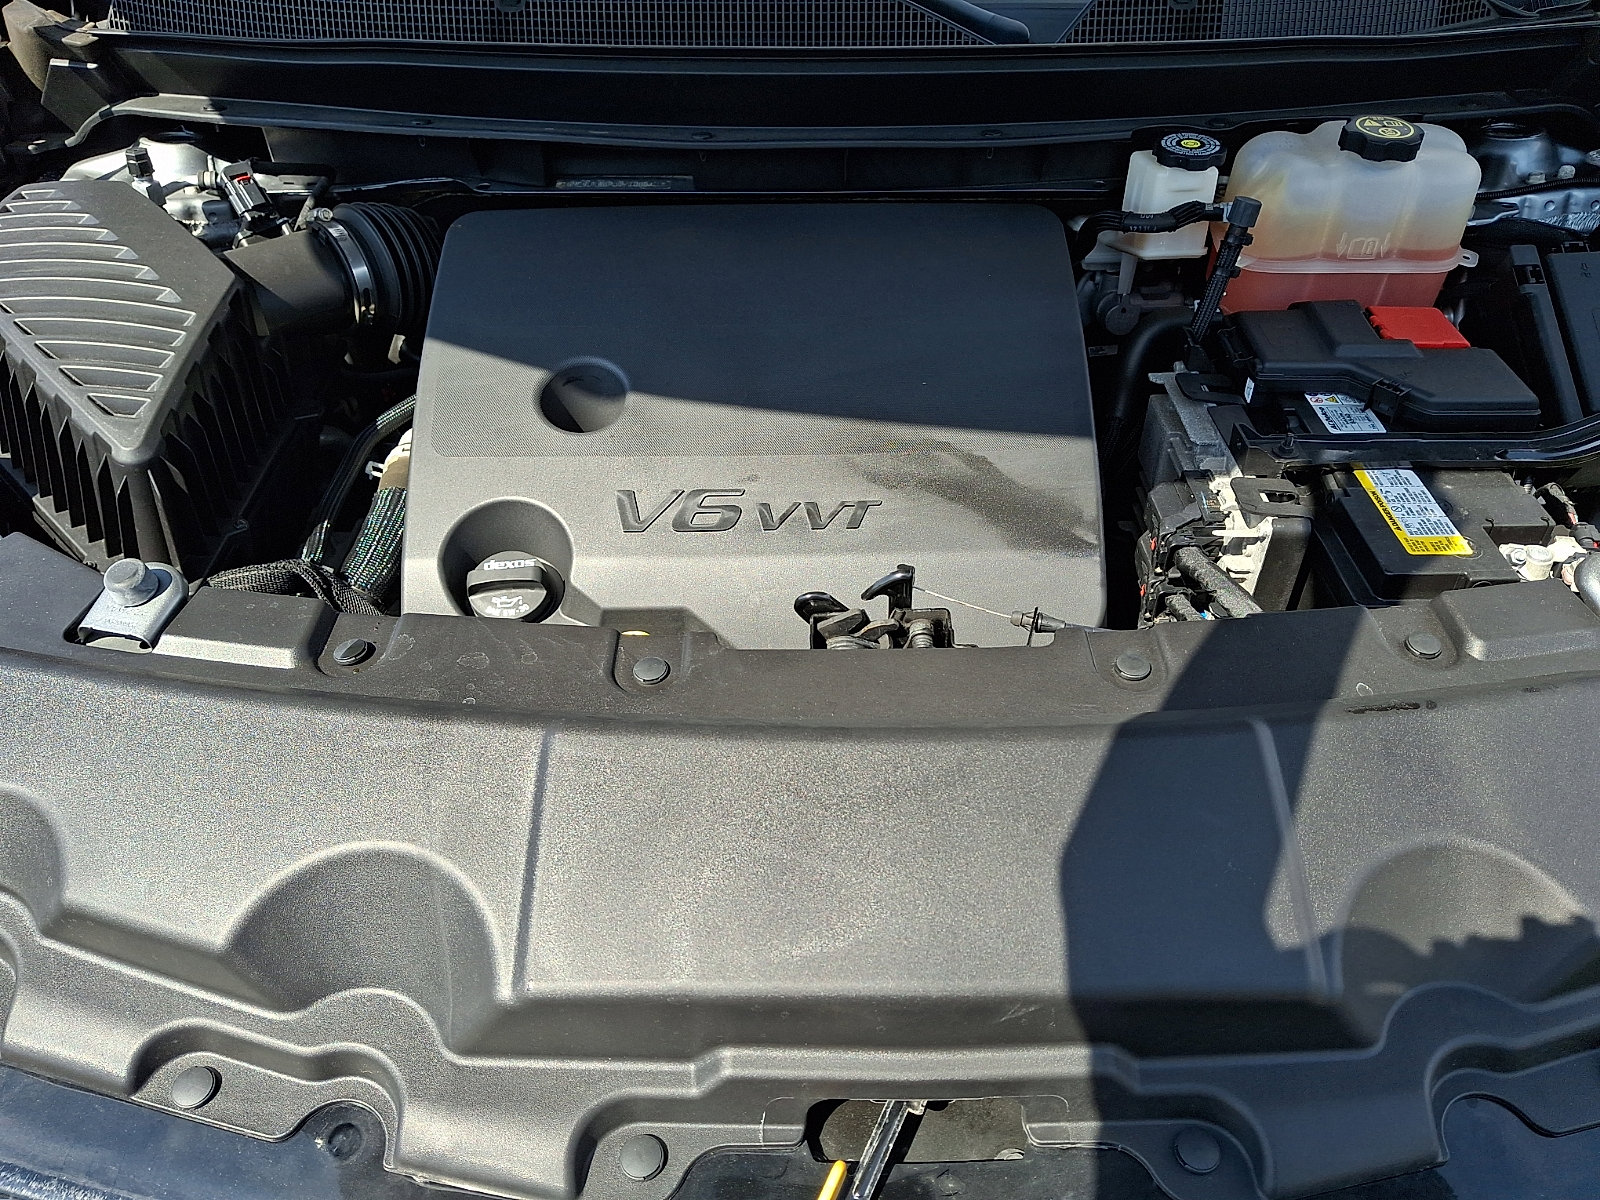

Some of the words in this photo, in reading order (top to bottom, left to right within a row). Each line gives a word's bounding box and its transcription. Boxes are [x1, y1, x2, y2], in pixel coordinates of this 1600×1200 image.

[615, 488, 745, 533] V6
[755, 500, 882, 531] VVT
[483, 558, 537, 571] dexos
